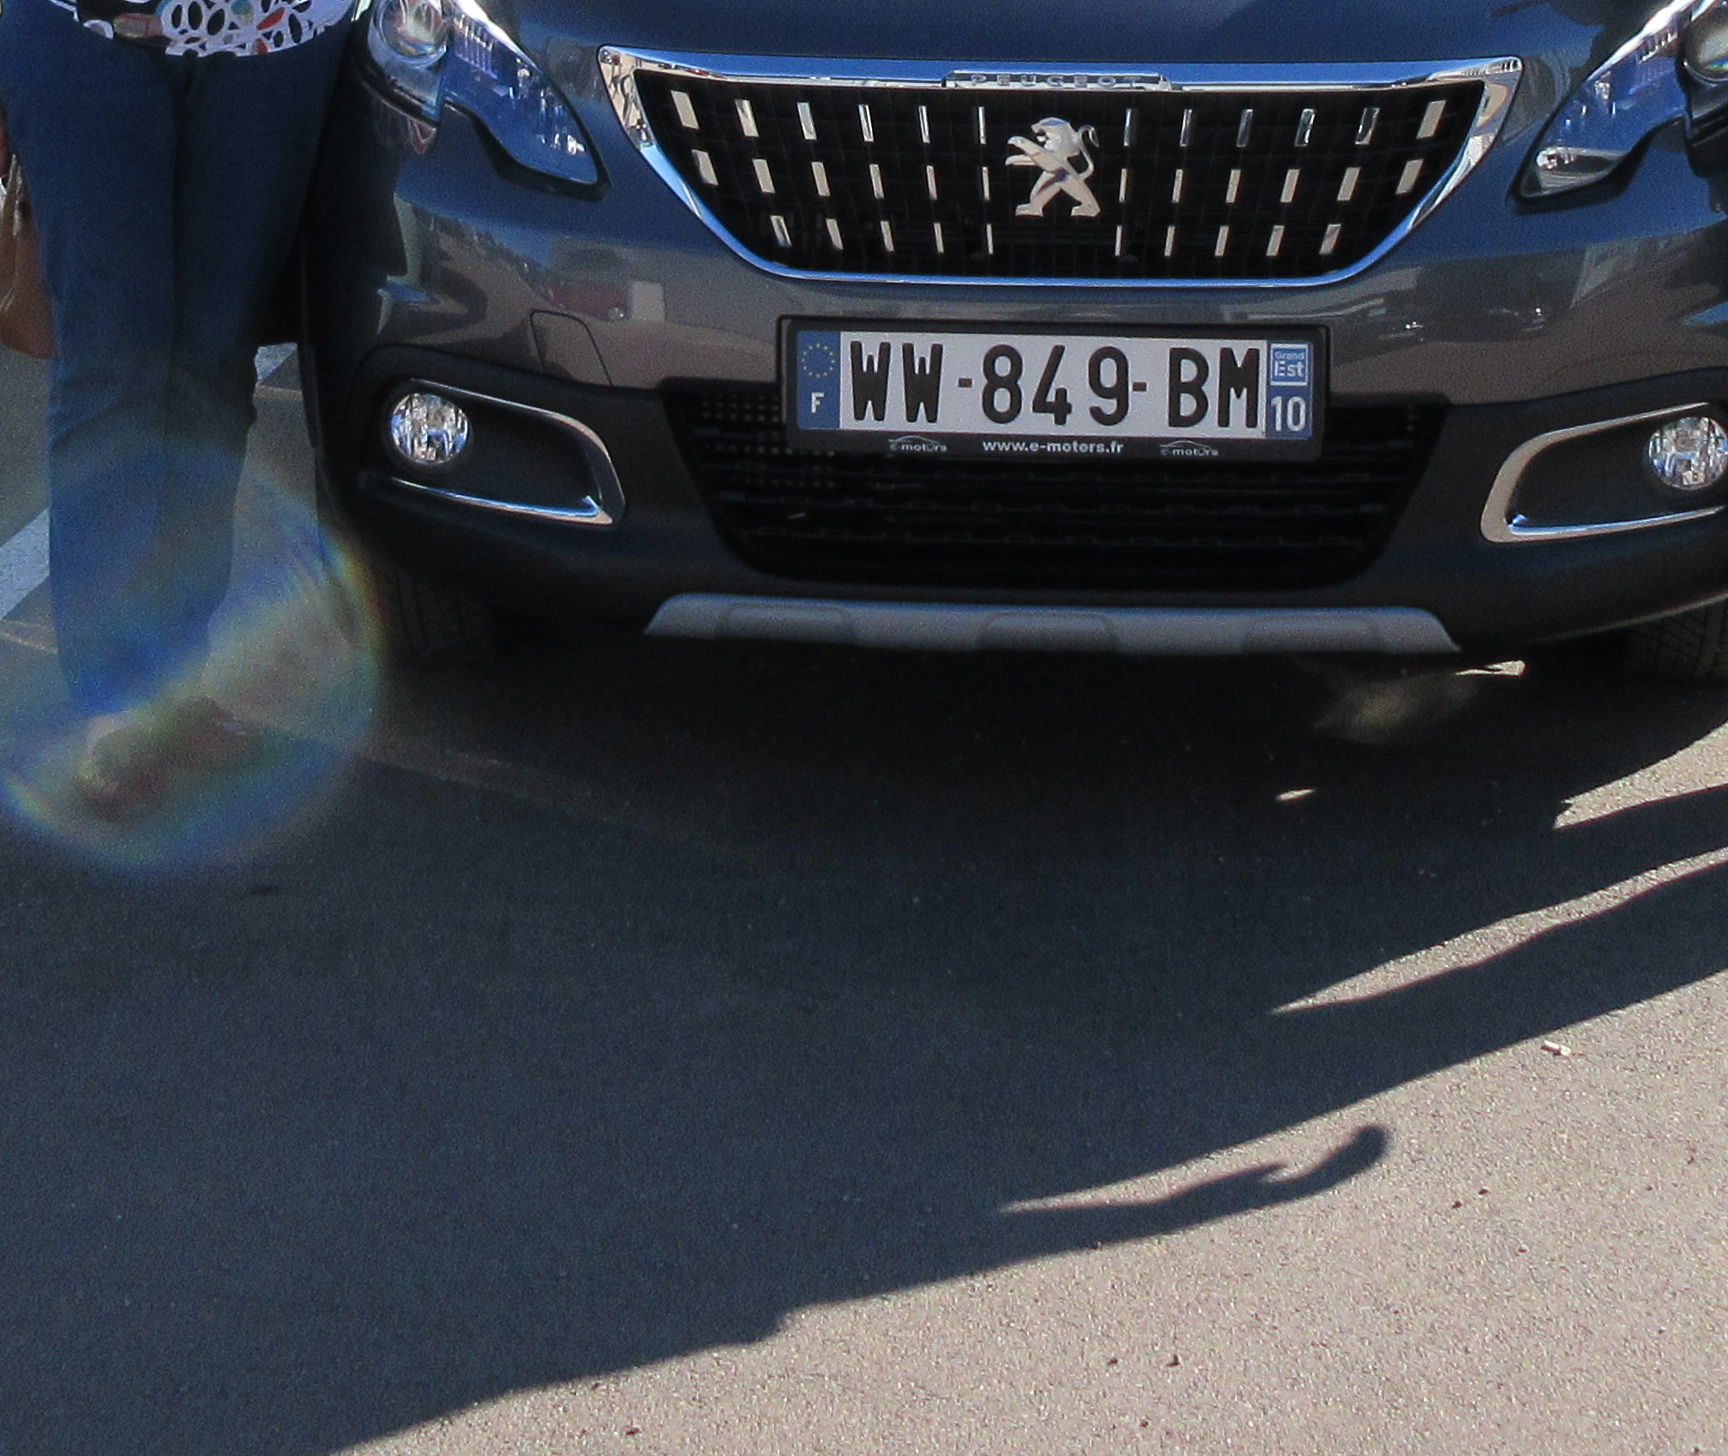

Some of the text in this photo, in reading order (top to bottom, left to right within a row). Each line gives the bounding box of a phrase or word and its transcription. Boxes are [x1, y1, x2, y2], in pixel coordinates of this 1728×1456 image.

[970, 73, 1143, 89] PEUGEOT
[1274, 350, 1305, 361] Grand
[1274, 361, 1305, 378] Est
[849, 340, 1261, 429] WW-849-BM
[810, 392, 825, 414] F
[1270, 395, 1307, 433] 10
[982, 439, 1124, 454] www.e-motors.fr
